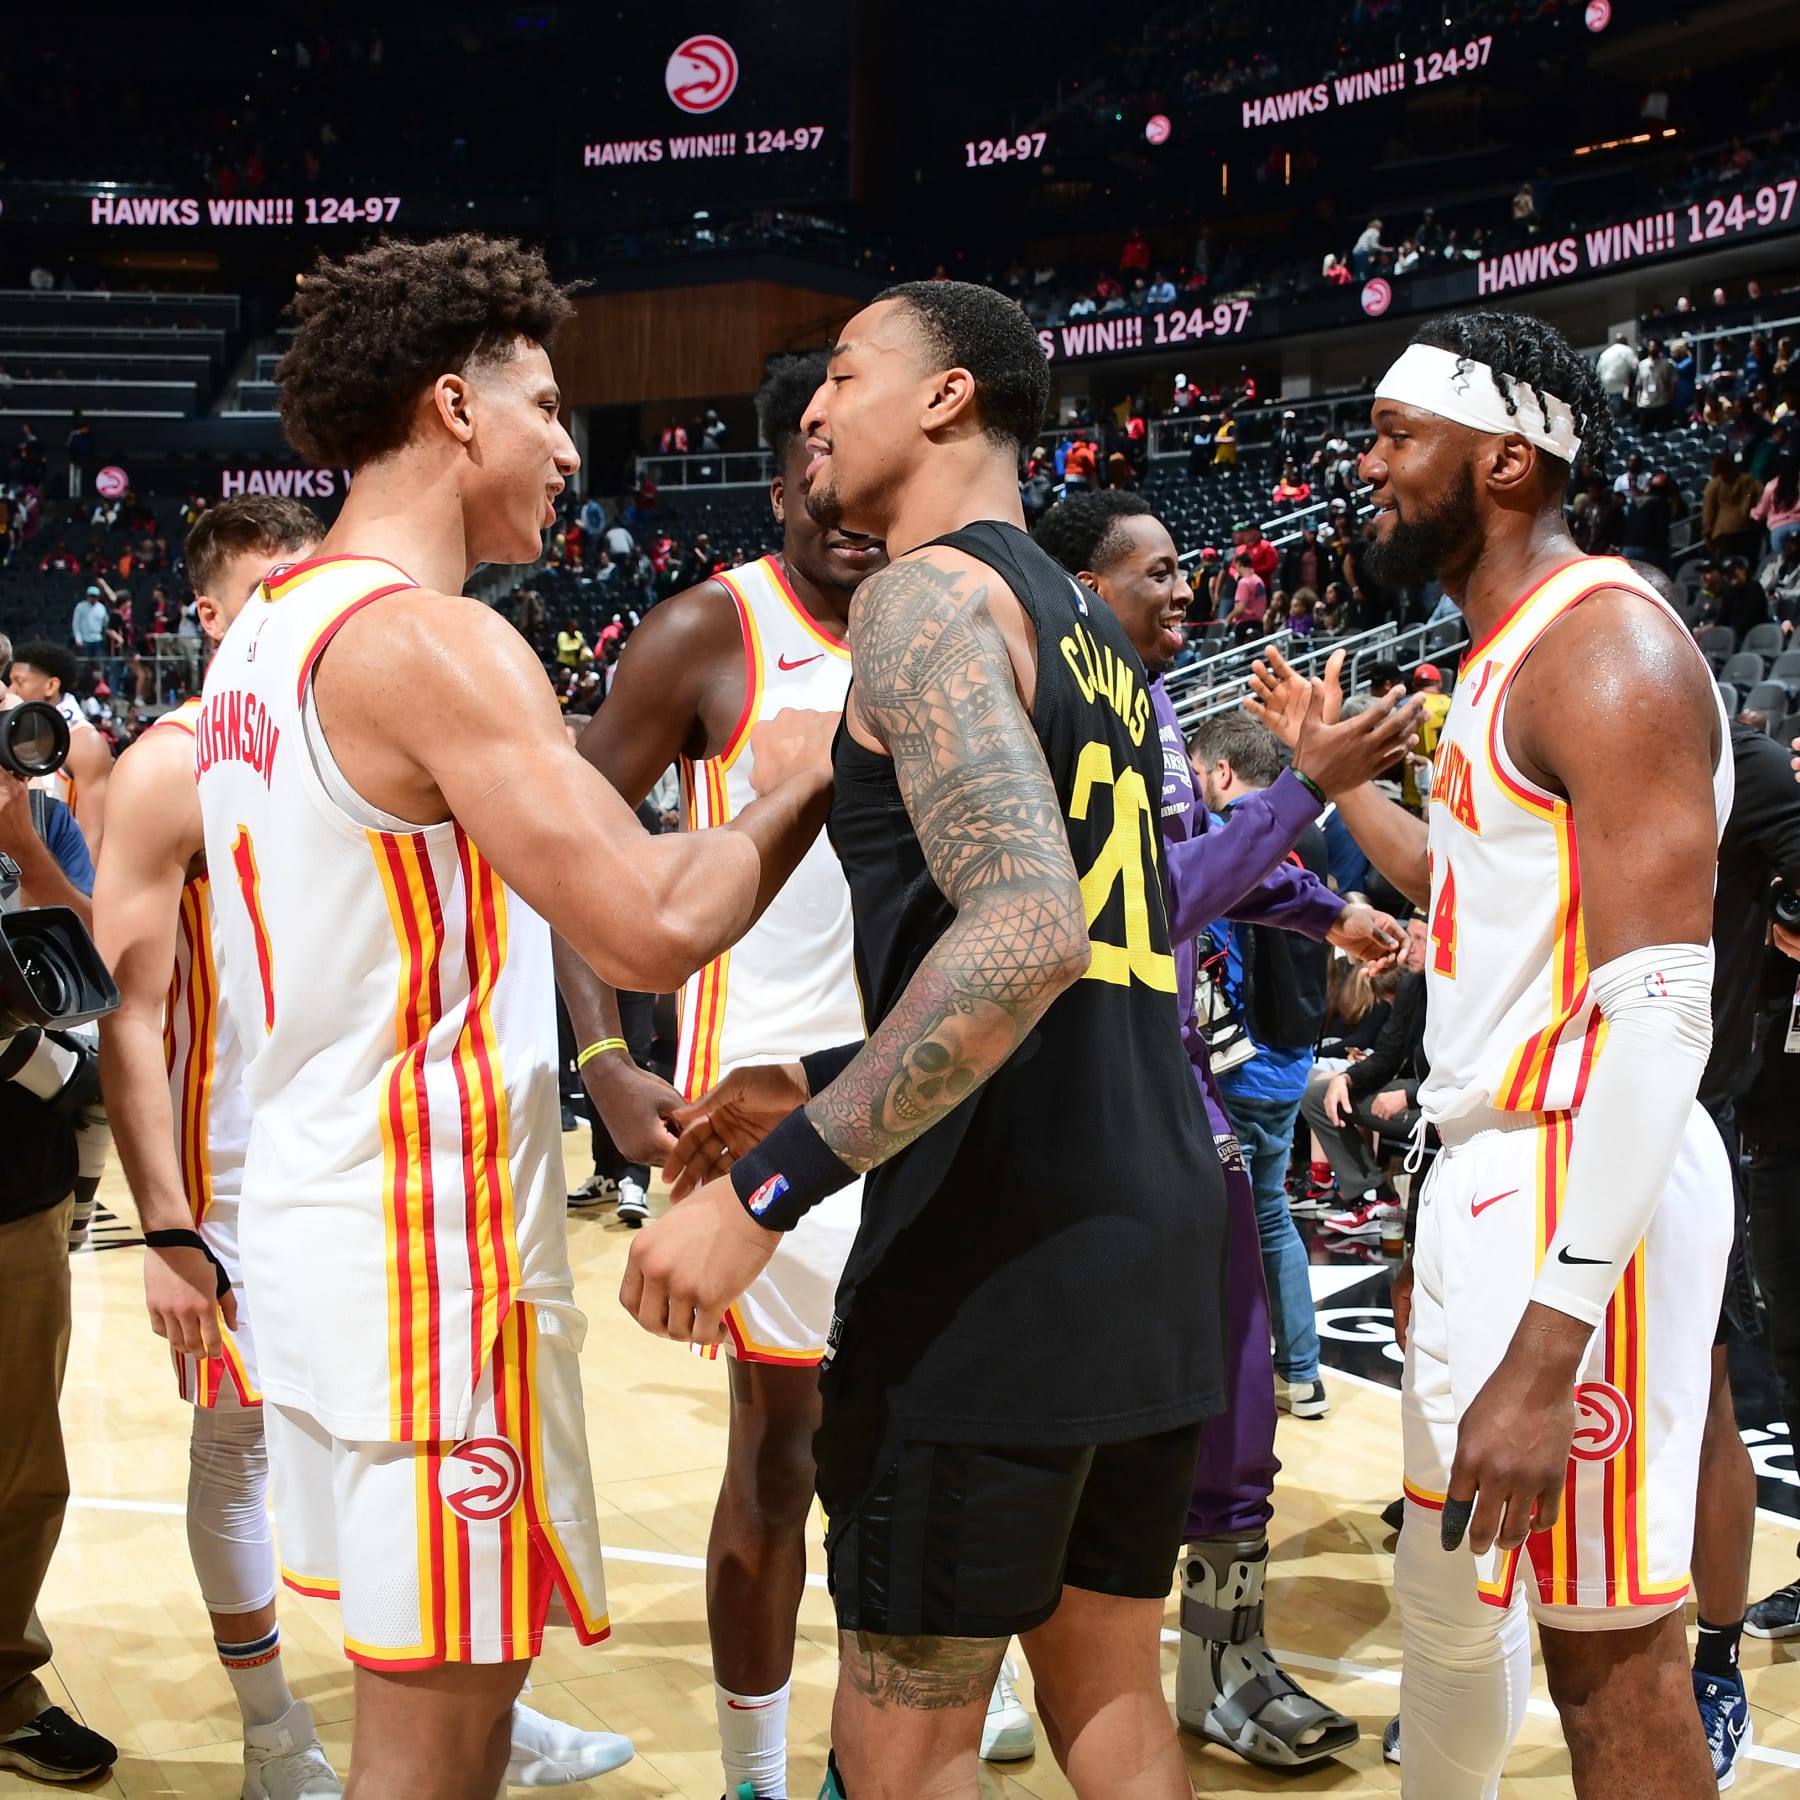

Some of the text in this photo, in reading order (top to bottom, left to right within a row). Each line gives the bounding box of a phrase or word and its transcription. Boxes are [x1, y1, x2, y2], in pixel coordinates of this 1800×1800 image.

[1242, 34, 1492, 128] HAWKS WIN!!! 124-97
[583, 126, 824, 167] HAWKS WIN!!! 124-97
[965, 131, 1047, 168] 124-97
[91, 197, 401, 226] HAWKS WIN!!! 124-97
[1477, 179, 1798, 296] HAWKS WIN!!! 124-97
[1061, 315, 1142, 357] WIN!!!
[1153, 301, 1249, 344] 124-97
[222, 469, 335, 498] HAWKS
[194, 690, 280, 793] JOHNSON
[1068, 740, 1179, 994] 20
[1428, 847, 1457, 981] 4
[230, 823, 276, 1037] 1
